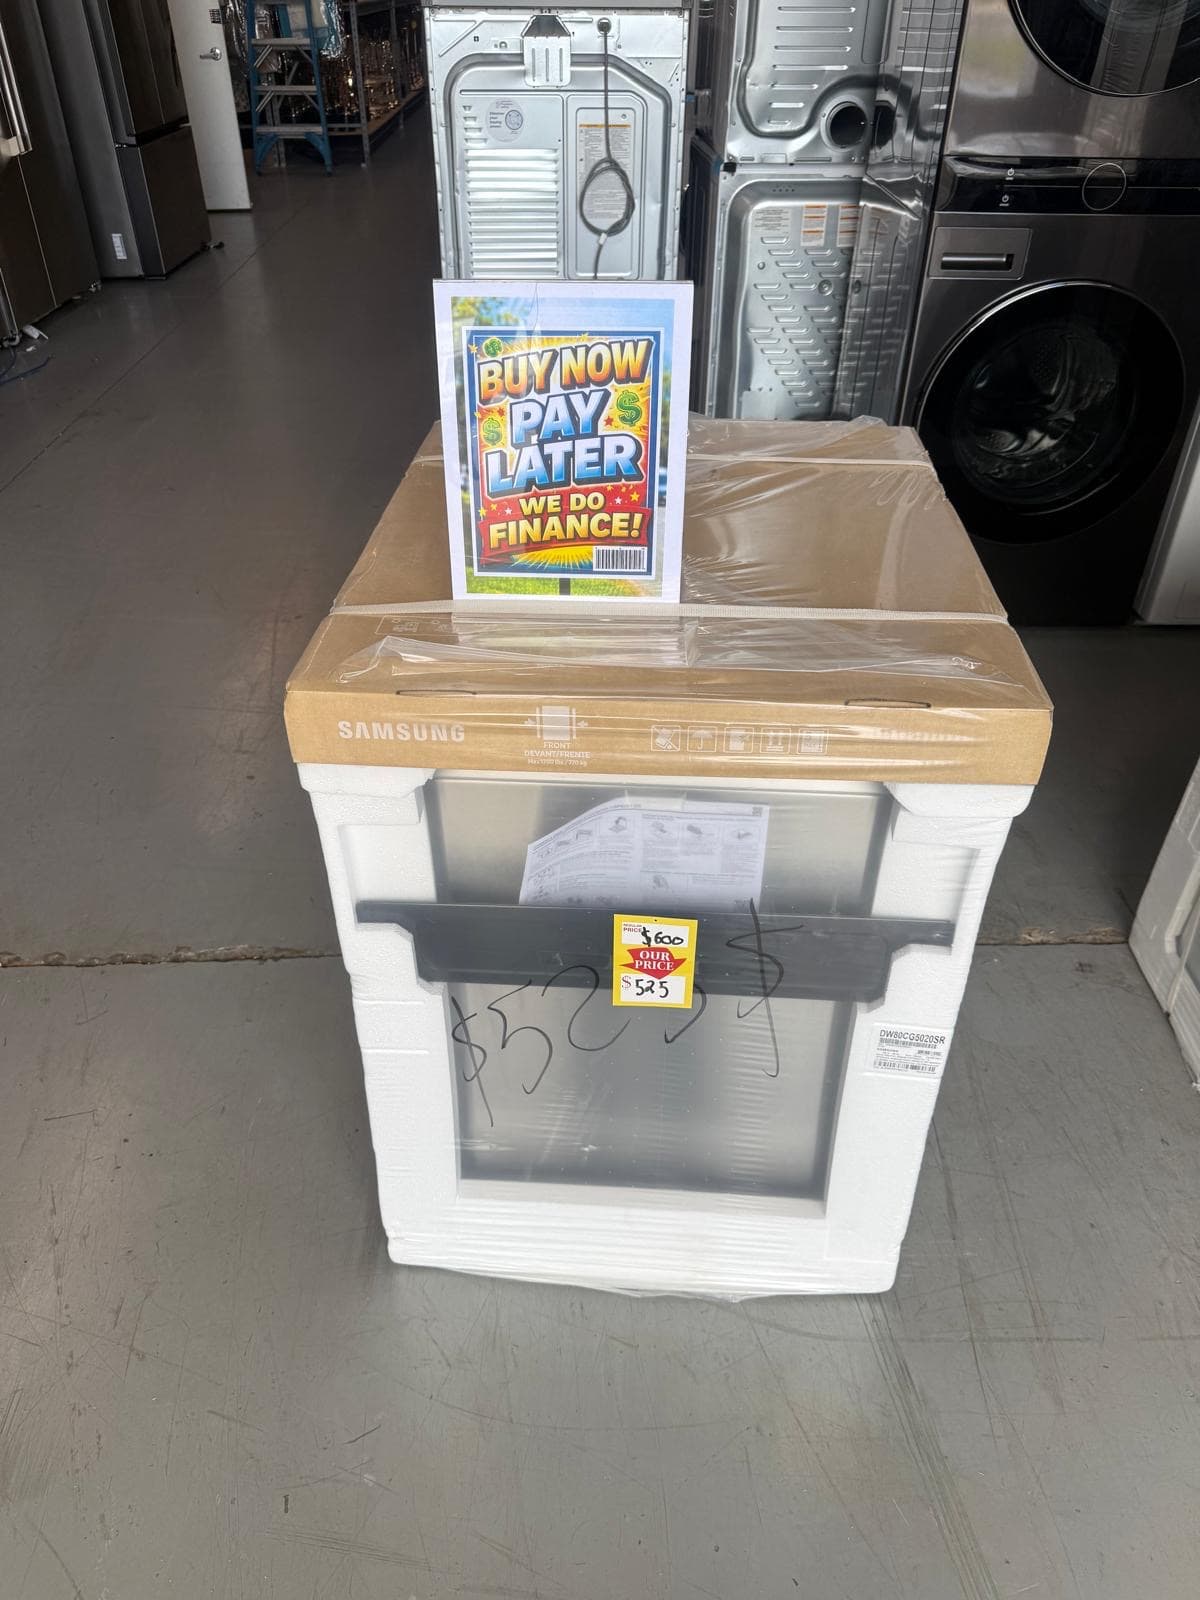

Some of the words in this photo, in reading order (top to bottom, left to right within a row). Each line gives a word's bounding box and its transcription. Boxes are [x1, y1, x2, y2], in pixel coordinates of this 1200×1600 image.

[478, 350, 558, 404] BUY
[561, 339, 655, 386] NOW
[510, 389, 612, 447] PAY
[486, 434, 644, 498] LATER
[520, 493, 562, 516] WE
[570, 491, 605, 512] DO
[488, 513, 643, 549] FINANCE!
[338, 720, 465, 742] SAMSUNG
[543, 741, 571, 750] FRONT
[641, 926, 684, 948] $600
[635, 960, 674, 971] PRICE
[640, 950, 670, 961] OUR
[880, 1029, 946, 1045] DW80CG5020SR
